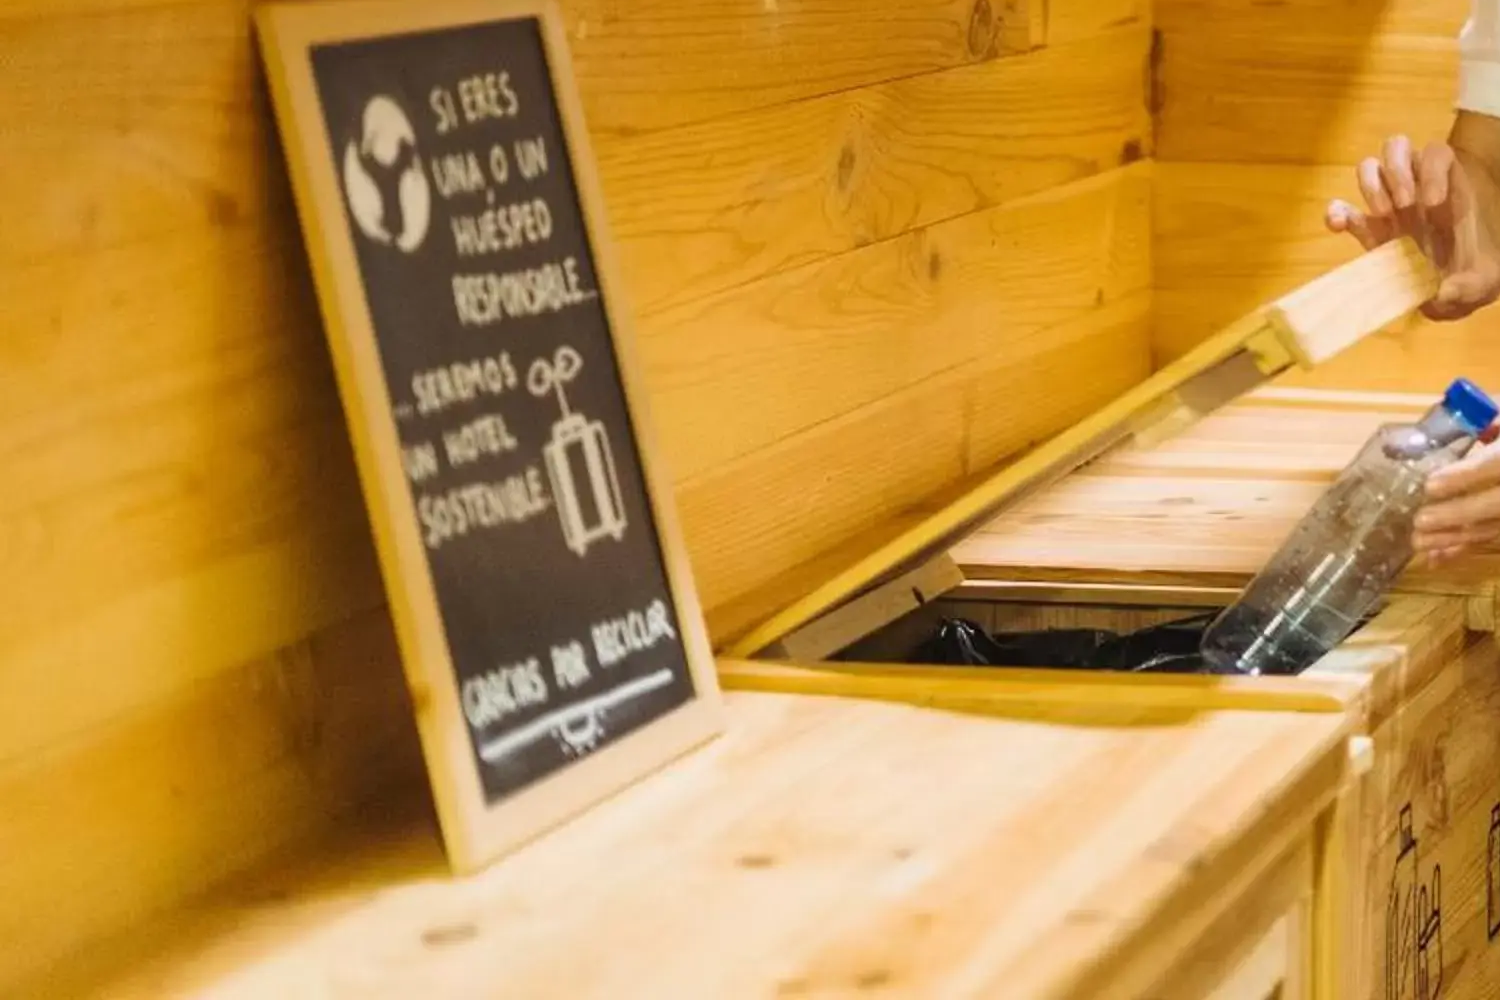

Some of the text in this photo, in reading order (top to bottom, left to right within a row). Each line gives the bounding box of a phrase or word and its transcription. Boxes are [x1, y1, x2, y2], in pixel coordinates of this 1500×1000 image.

[430, 71, 518, 134] SI ERES
[430, 151, 486, 198] UNA
[515, 136, 549, 178] UN
[443, 413, 518, 466] HOTEL
[460, 598, 676, 727] GRACIAS POR RECICLAR
